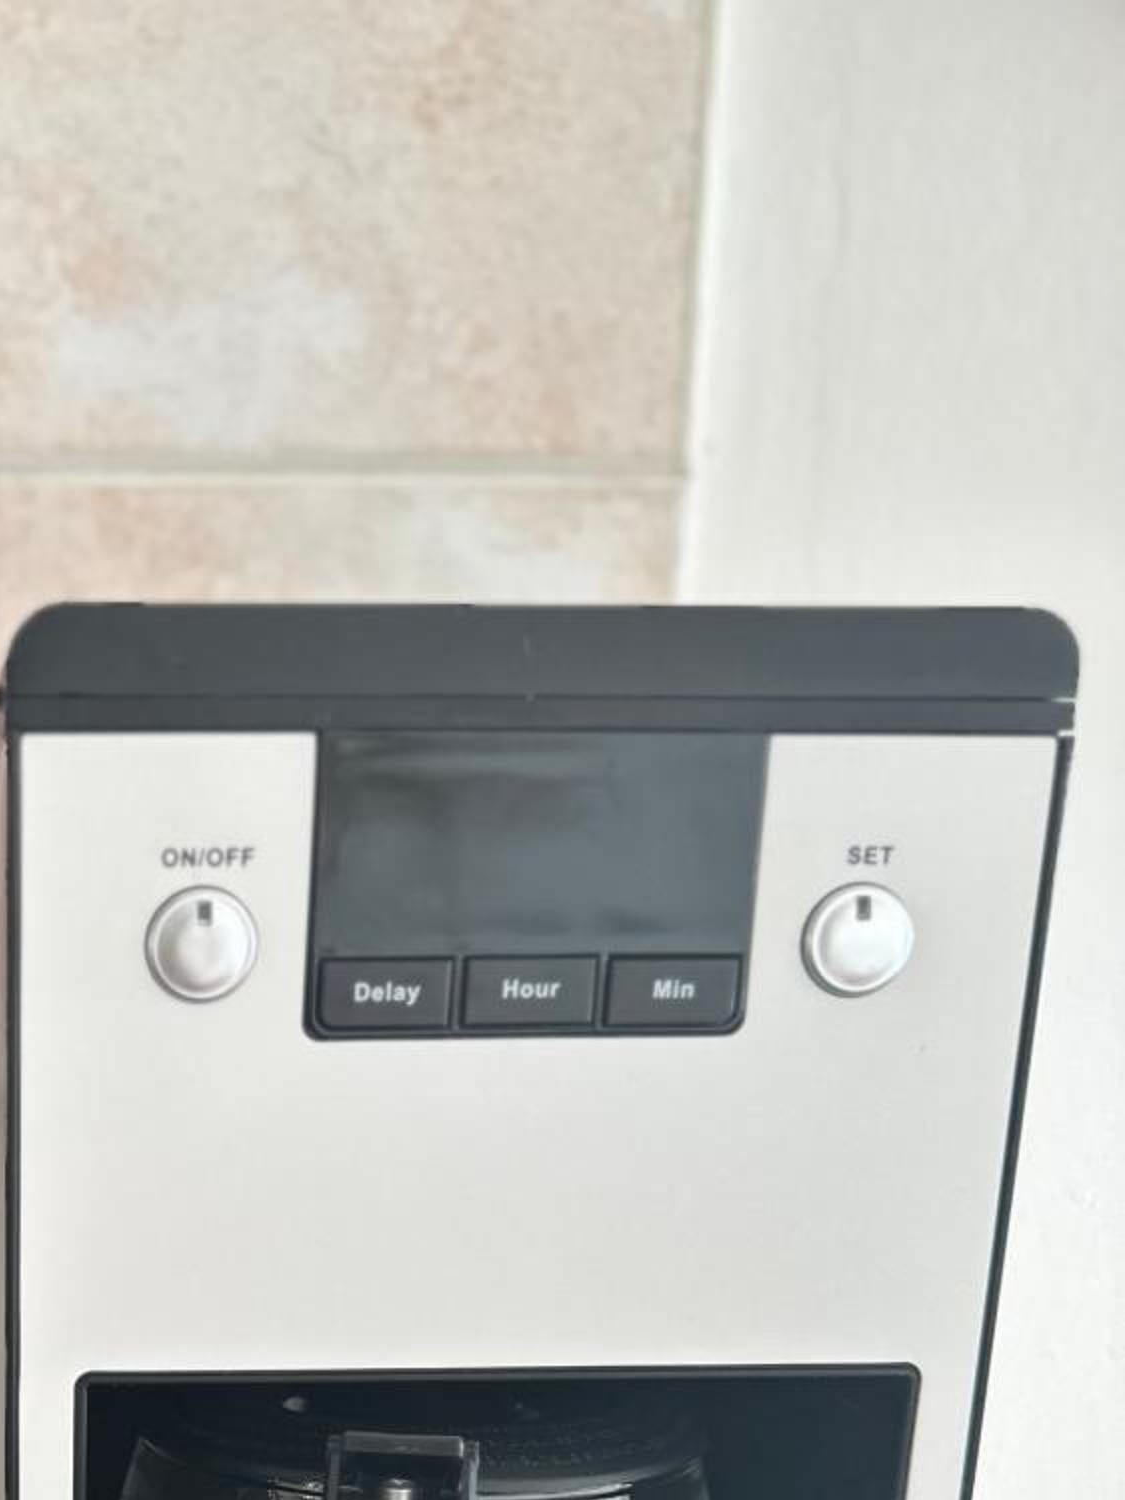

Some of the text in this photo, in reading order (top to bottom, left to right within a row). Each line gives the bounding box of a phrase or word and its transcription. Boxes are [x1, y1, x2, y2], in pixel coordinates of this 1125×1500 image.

[161, 846, 255, 868] ON/OFF
[847, 845, 895, 867] SET
[353, 981, 421, 1006] Delay
[501, 978, 561, 999] Hour
[652, 978, 695, 999] Min
